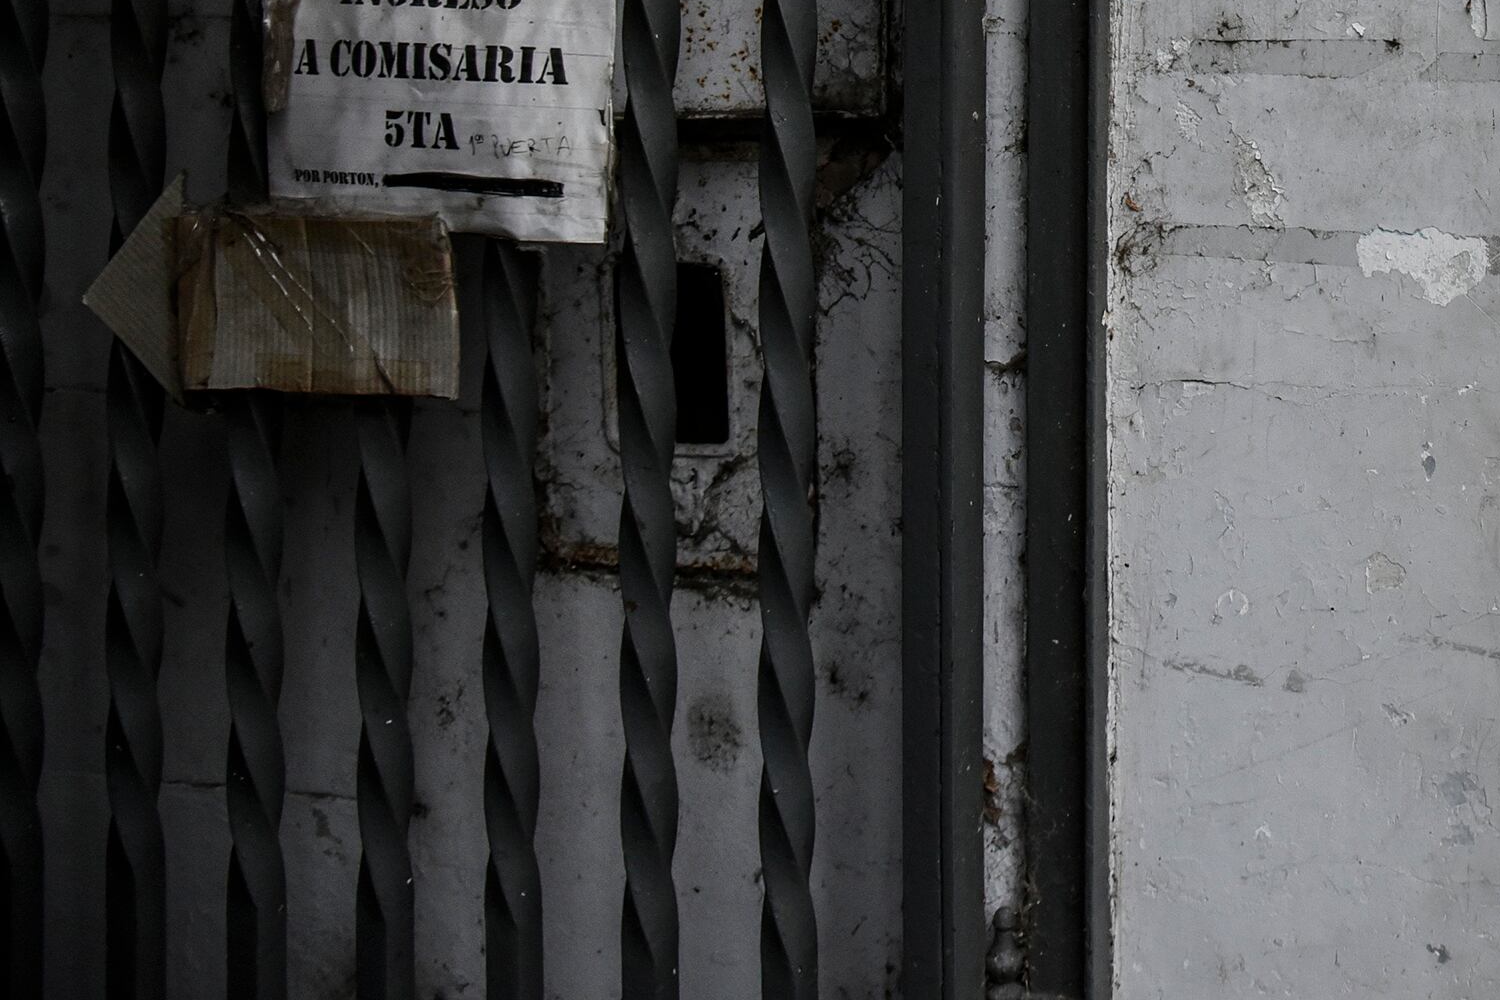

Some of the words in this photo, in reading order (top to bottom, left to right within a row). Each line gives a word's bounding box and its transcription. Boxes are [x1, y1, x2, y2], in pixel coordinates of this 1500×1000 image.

[294, 39, 319, 75] A
[330, 40, 568, 85] COMISARIA
[384, 110, 460, 150] 5TA
[491, 134, 573, 159] PUERTA
[295, 168, 320, 182] POR
[323, 170, 379, 188] PORTON,
